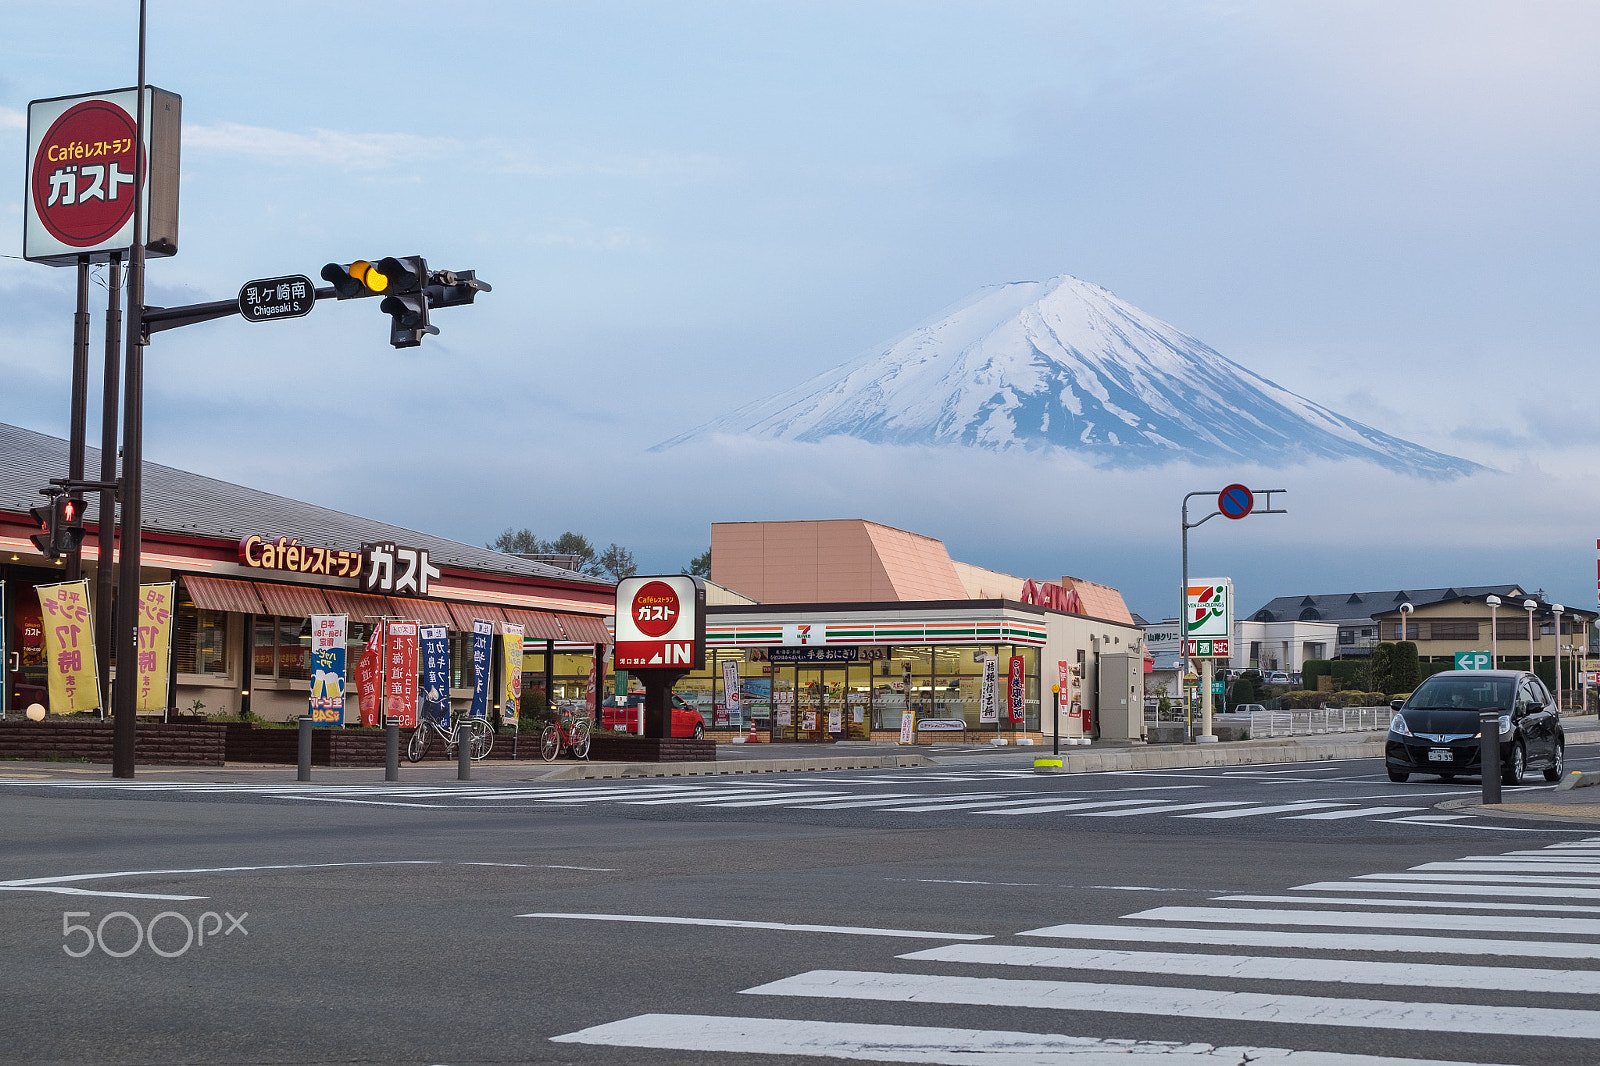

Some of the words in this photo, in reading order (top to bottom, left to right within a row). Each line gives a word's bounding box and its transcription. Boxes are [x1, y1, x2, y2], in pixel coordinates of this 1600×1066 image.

[47, 163, 134, 207] ガスト
[253, 302, 291, 316] Chigasaki
[293, 301, 302, 311] S.
[368, 545, 440, 594] ガスト
[638, 605, 675, 621] ガスト
[664, 643, 691, 664] IN
[1199, 642, 1210, 653] 酒
[1213, 642, 1228, 653] たばこ
[1474, 654, 1488, 670] P
